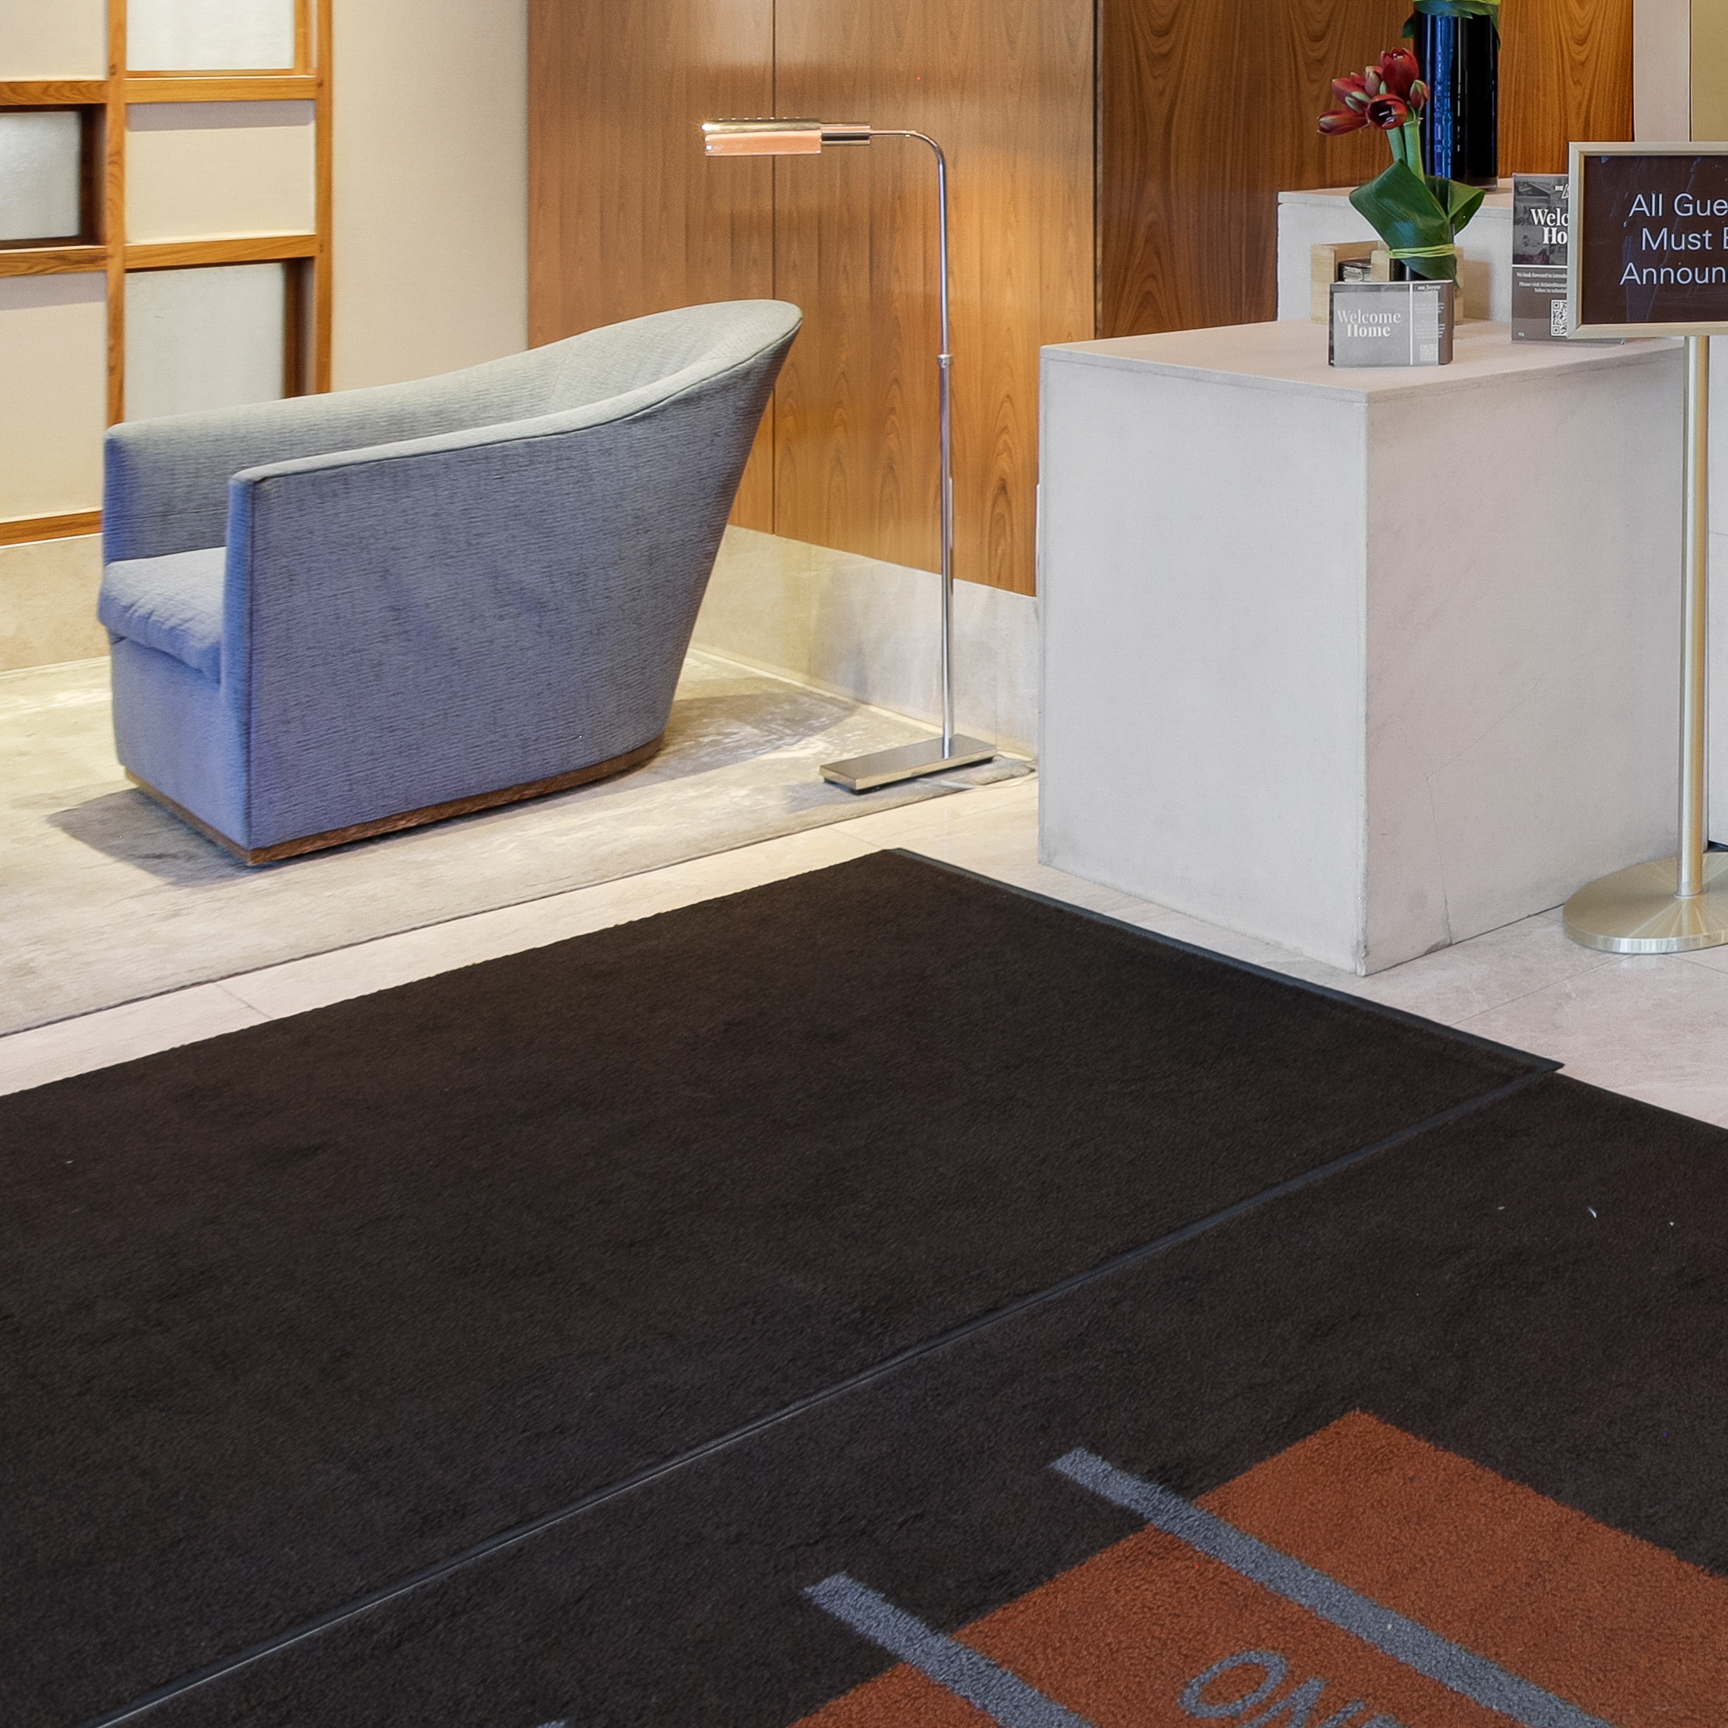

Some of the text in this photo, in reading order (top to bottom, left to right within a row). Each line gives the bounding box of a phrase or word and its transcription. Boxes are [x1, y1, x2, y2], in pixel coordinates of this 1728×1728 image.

[1628, 193, 1663, 217] All
[1530, 207, 1569, 226] Welc
[1542, 226, 1568, 245] Ho
[1641, 227, 1713, 251] Must
[1337, 309, 1402, 324] Welcome
[1346, 324, 1392, 338] Home
